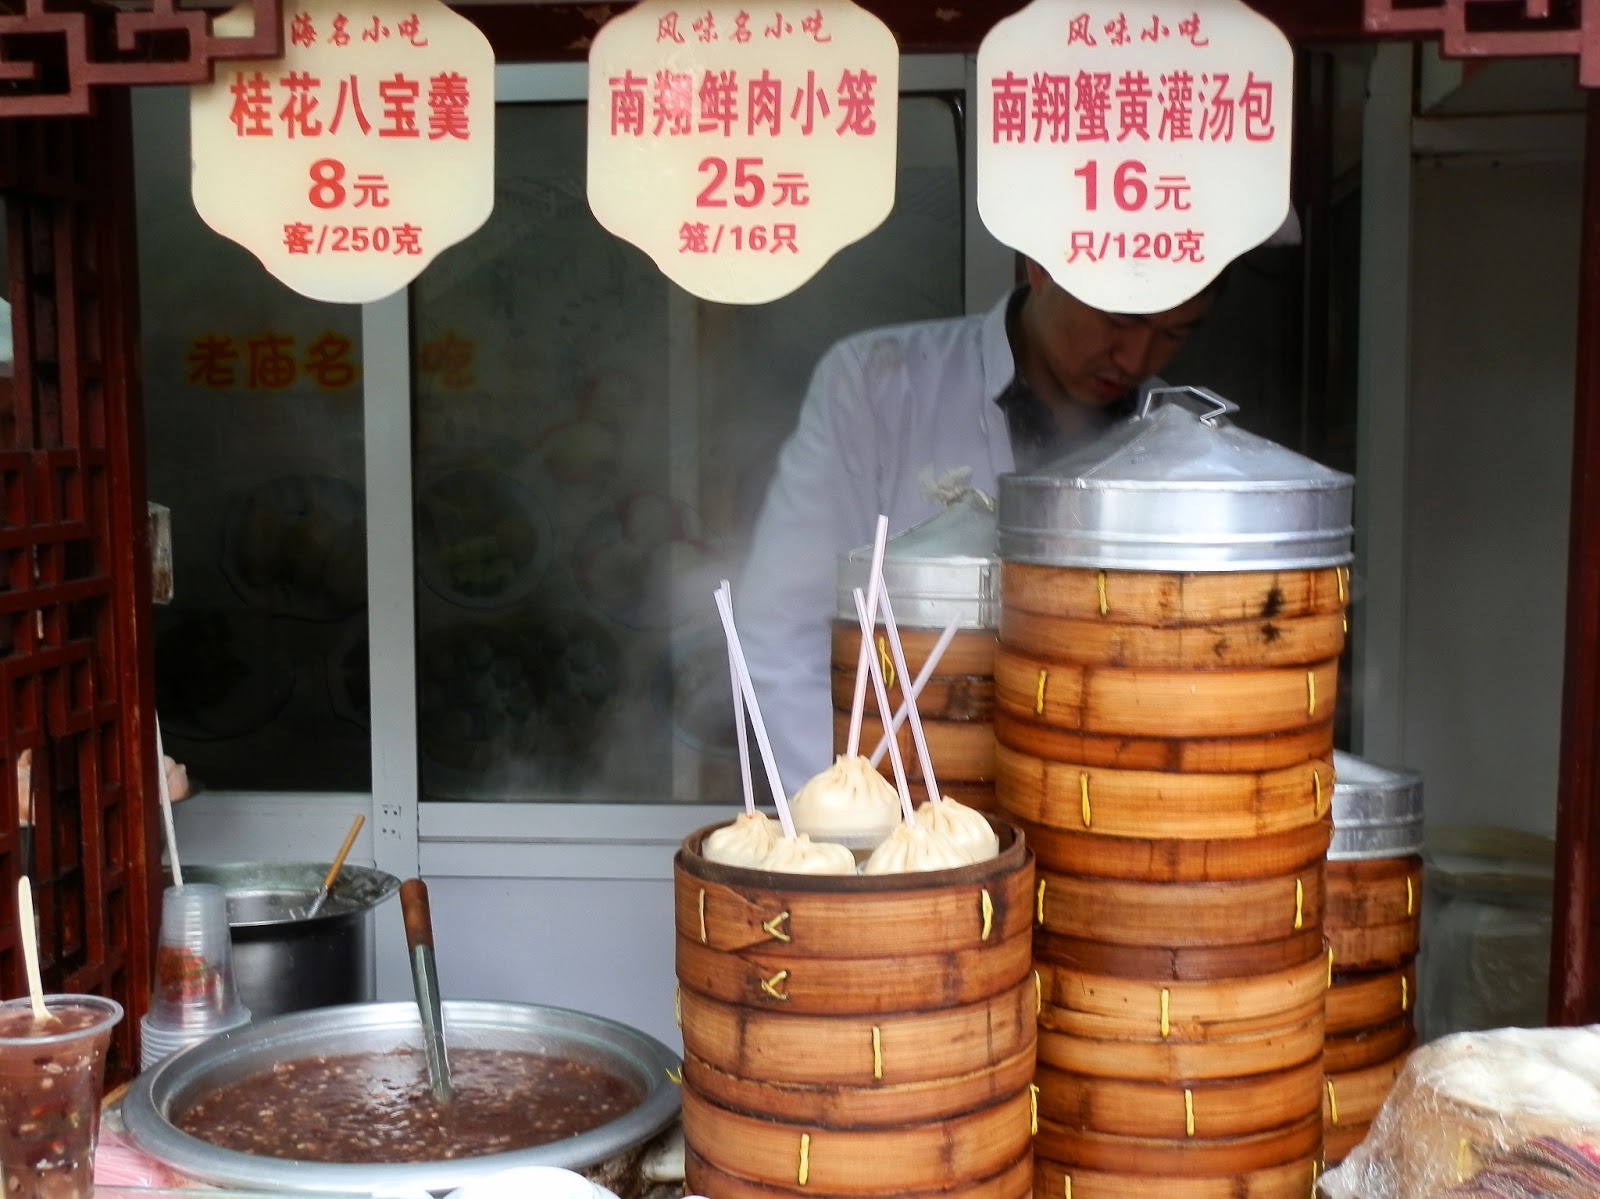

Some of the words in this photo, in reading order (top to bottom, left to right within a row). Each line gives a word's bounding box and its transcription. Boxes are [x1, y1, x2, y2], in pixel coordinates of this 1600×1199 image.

[289, 13, 428, 48] 海名小吃
[657, 10, 832, 44] 风味名小吃
[1067, 13, 1209, 47] 风味小吃
[229, 71, 470, 141] 桂花八宝羹
[608, 69, 877, 137] 南翔鲜肉小笼
[991, 70, 1275, 144] 南翔蟹黄灌汤包
[308, 158, 390, 210] 8元
[695, 157, 810, 209] 25元
[1074, 159, 1192, 212] 16元
[282, 222, 423, 255] 客/250克
[678, 222, 799, 254] 笼/16只
[1067, 229, 1205, 264] 只/120克
[187, 332, 476, 389] 老庙名吃
